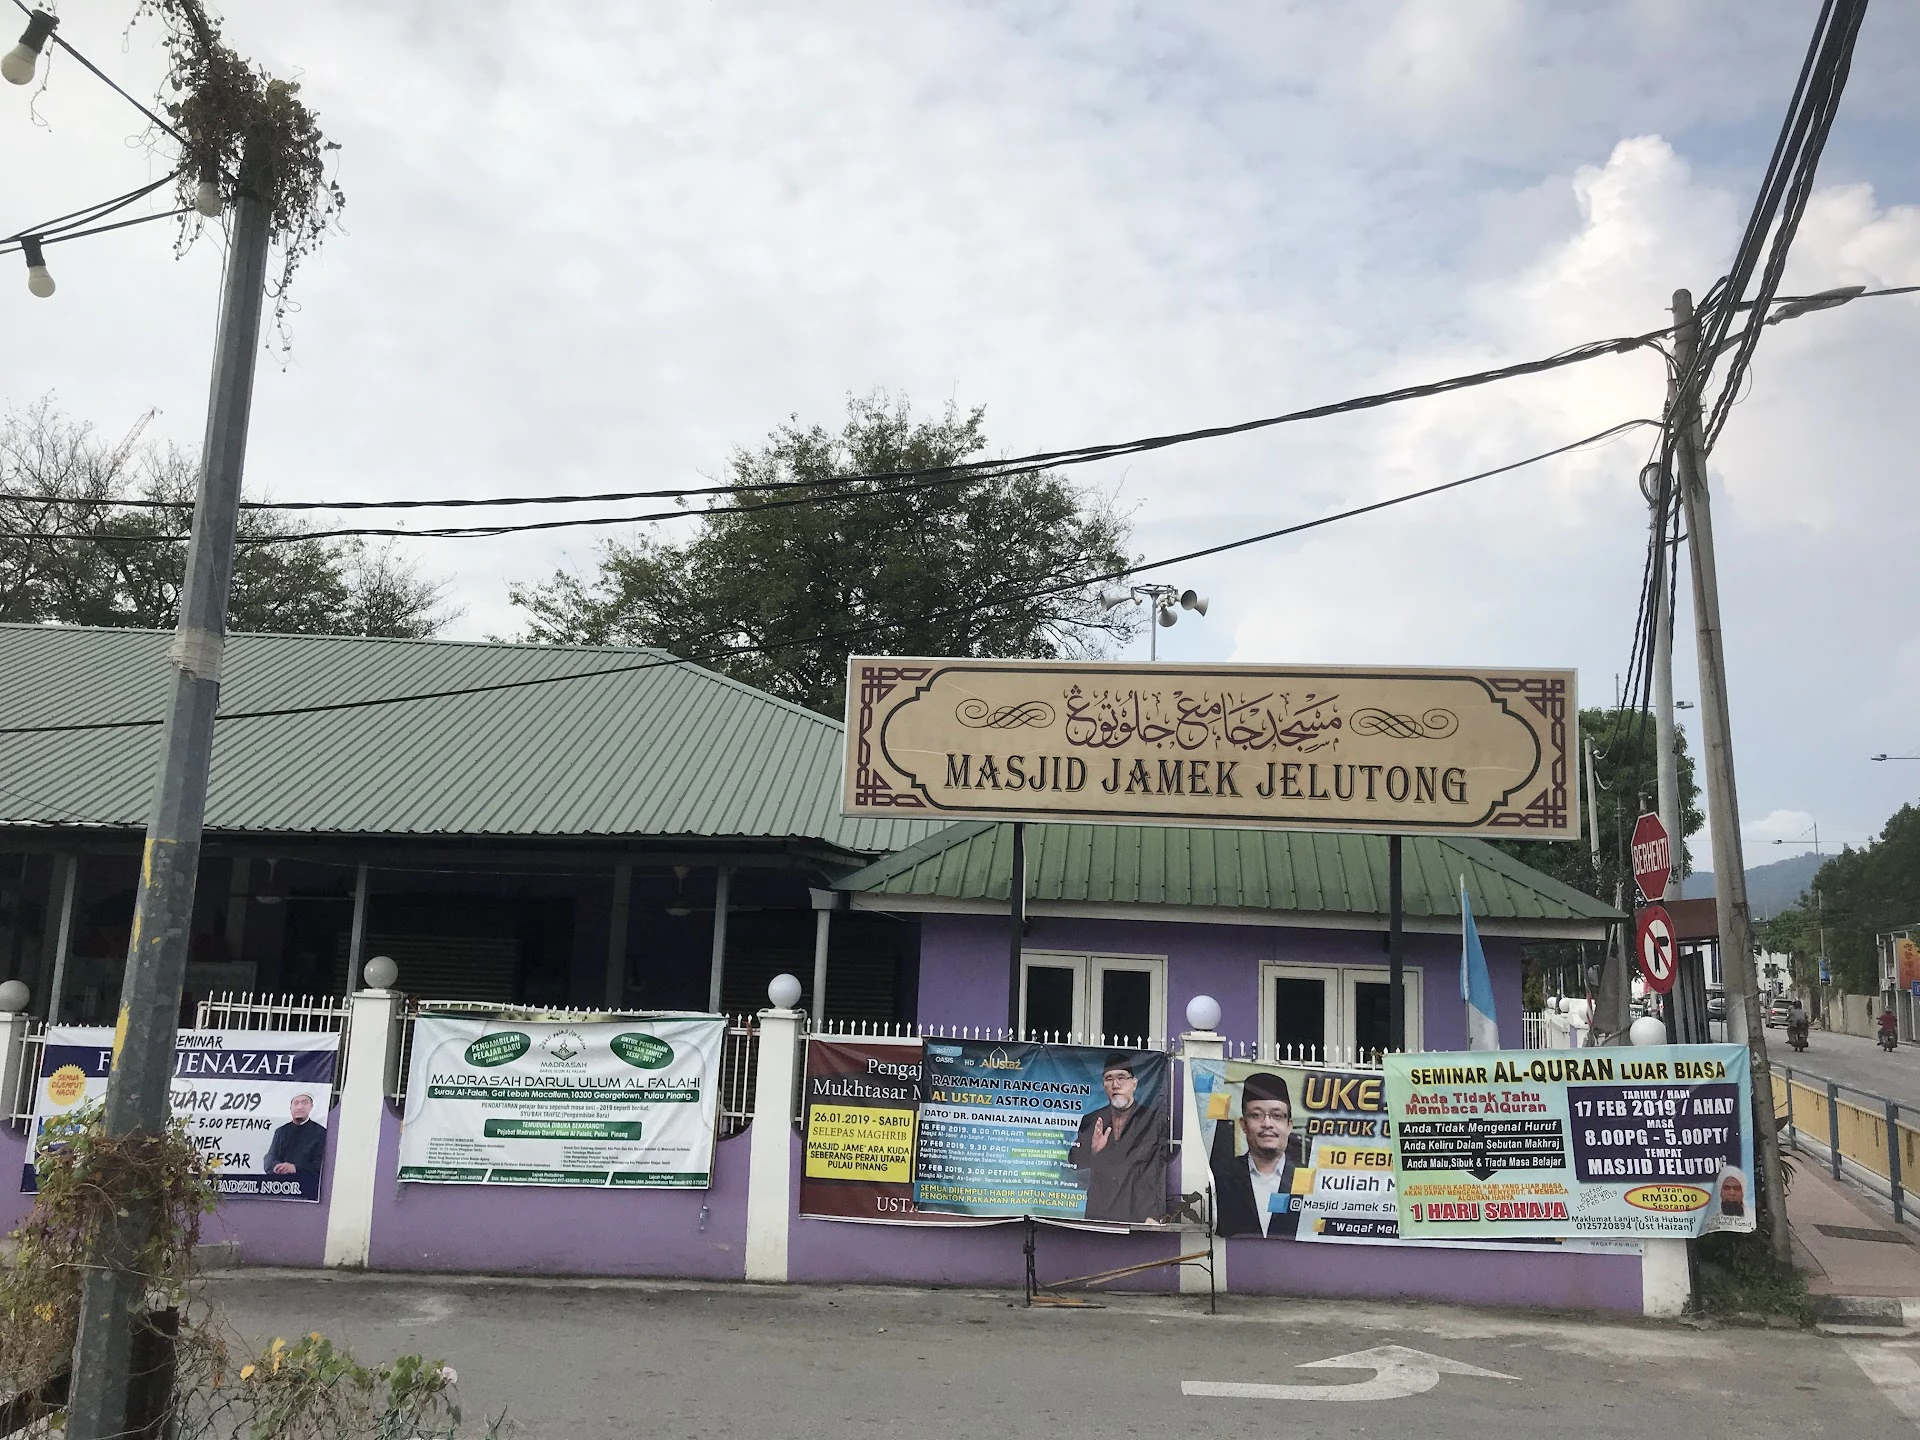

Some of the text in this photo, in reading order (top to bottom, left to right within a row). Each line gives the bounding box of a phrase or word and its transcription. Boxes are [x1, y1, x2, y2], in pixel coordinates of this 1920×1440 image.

[943, 753, 1469, 804] MASJID JAMEK JELUTONG
[1633, 837, 1669, 876] BERHENTI
[175, 1035, 224, 1049] EMINAR
[471, 1034, 521, 1053] PENGAMBILAN
[473, 1046, 502, 1061] PELAJAR
[503, 1041, 521, 1054] BARU
[171, 1052, 296, 1078] JENAZAH
[1411, 1058, 1726, 1085] SEMINAR AL-QURAN LUAR BIASA
[430, 1074, 701, 1089] MADRASAH DARUL ULUM AL FALAHI
[812, 1078, 908, 1100] Mukhtasar
[931, 1074, 1091, 1096] RAKAMAN RANCANGAN
[433, 1087, 455, 1097] Surau
[456, 1088, 490, 1098] Al-Falah,
[491, 1090, 506, 1098] Gat
[507, 1090, 530, 1098] Lebuh
[570, 1090, 592, 1099] 10300
[666, 1092, 694, 1101] Pinang.
[931, 1090, 948, 1102] AL
[951, 1092, 993, 1105] USTAZ
[995, 1095, 1040, 1108] ASTRO
[1042, 1098, 1083, 1111] OASIS
[1306, 1078, 1388, 1111] UKE
[1410, 1091, 1541, 1105] Anda Tidak Tahu
[1621, 1090, 1658, 1100] TARIKH
[220, 1092, 262, 1112] 2019
[1405, 1102, 1547, 1115] Membaca AlQuran
[1574, 1101, 1593, 1117] 17
[1596, 1100, 1628, 1117] FEB
[1631, 1099, 1676, 1117] 2019
[1692, 1098, 1734, 1116] AHAD
[199, 1117, 224, 1129] 5.00
[225, 1118, 272, 1131] PETANG
[814, 1112, 911, 1127] 26.01.2019 SABTU
[954, 1112, 969, 1120] DR.
[971, 1113, 1007, 1123] DANIAL
[1008, 1115, 1044, 1125] ZAINAL
[1044, 1117, 1079, 1127] ABIDIN
[1646, 1119, 1675, 1129] MASA
[812, 1126, 908, 1141] SELEPAS MAGHRIB
[1308, 1119, 1375, 1136] DATUK
[1403, 1123, 1432, 1134] Anda
[1435, 1123, 1465, 1133] Tidak
[1468, 1121, 1522, 1135] Mengenal
[1524, 1121, 1557, 1132] Huruf
[1403, 1138, 1560, 1151] Anda Keliru Dalam Sebutan Makhraj
[1584, 1129, 1648, 1146] 8.00PG
[808, 1141, 840, 1151] MASJID
[868, 1146, 884, 1154] ARA
[888, 1146, 910, 1155] KUDA
[1644, 1148, 1682, 1159] TEMPAT
[810, 1150, 906, 1164] SEBERANG PERAI UTARA
[1330, 1151, 1347, 1165] 10
[1406, 1156, 1563, 1169] Anda & Tiada Masa Belajar
[828, 1160, 889, 1172] PULAU PINANG
[1588, 1158, 1653, 1176] MASJID
[260, 1181, 302, 1195] NOOR
[1321, 1175, 1380, 1192] Kuliah
[919, 1192, 965, 1202] PENONTON
[966, 1195, 1008, 1204] RAKAMAN
[1010, 1198, 1064, 1206] RANCANGAN
[920, 1184, 948, 1192] SEMUA
[948, 1186, 987, 1196] DIJEMPUT
[990, 1189, 1016, 1197] HADIR
[1048, 1192, 1086, 1200] MENJADI
[1642, 1193, 1698, 1203] RM30.00
[1303, 1200, 1379, 1212] Masjid Jamek
[1410, 1201, 1569, 1220] 1 HARI SAHAJA
[1613, 1216, 1642, 1224] Lanjut,
[1660, 1216, 1696, 1225] Hubungi
[1635, 1222, 1655, 1232] (Ust
[1657, 1222, 1693, 1232] Haizan)
